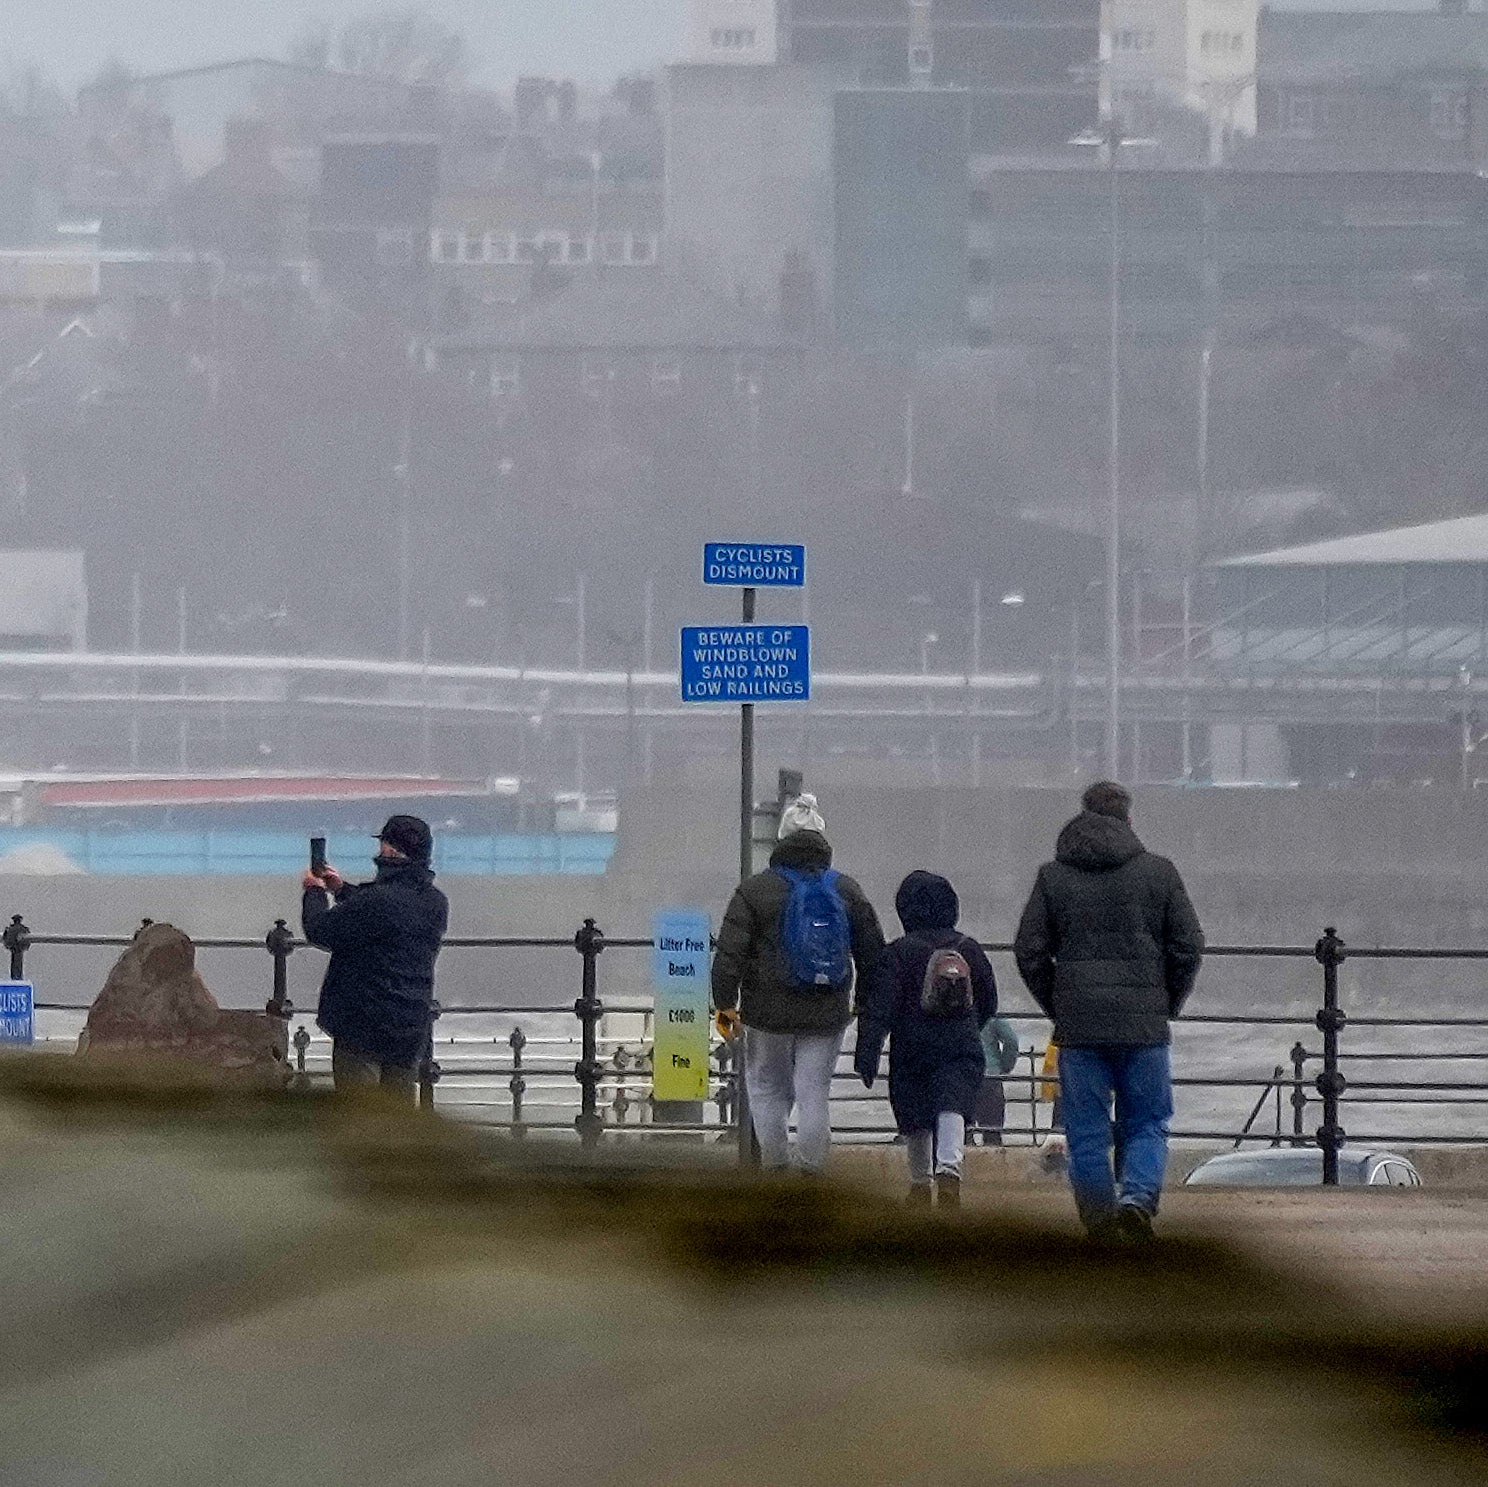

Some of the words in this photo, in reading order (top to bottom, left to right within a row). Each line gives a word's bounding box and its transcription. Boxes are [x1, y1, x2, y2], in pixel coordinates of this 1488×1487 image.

[715, 549, 793, 563] CYCLISTS
[709, 565, 799, 581] DISMOUNT
[698, 631, 765, 646] BEWARE
[771, 630, 792, 644] OF
[693, 647, 797, 662] WINDBLOWN
[702, 664, 748, 679] SAND
[753, 664, 788, 678] AND
[687, 681, 722, 696] LOW
[727, 681, 804, 696] RAILINGS
[660, 937, 683, 952] Litter
[685, 938, 705, 952] Free
[668, 963, 695, 977] Beach
[672, 1054, 691, 1069] Fine
